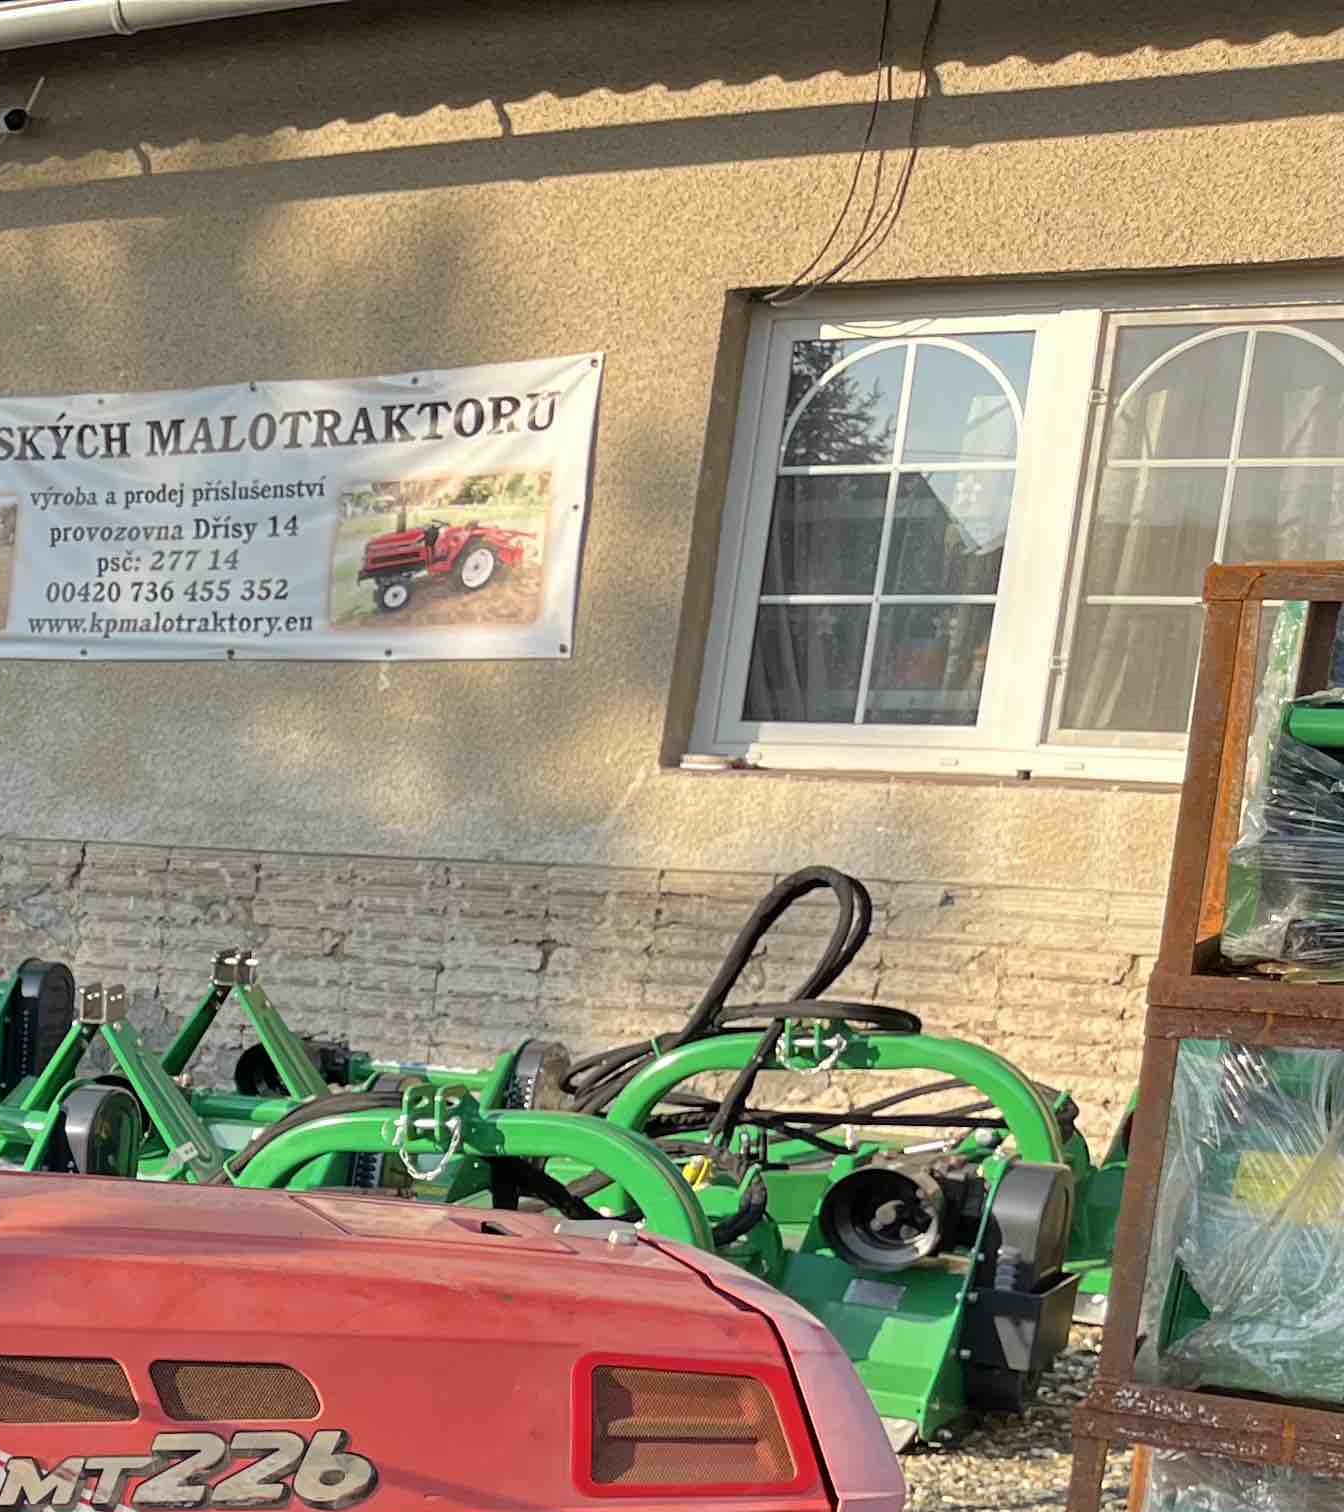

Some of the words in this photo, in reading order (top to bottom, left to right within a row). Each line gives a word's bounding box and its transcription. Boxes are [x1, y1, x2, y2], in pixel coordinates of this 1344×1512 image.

[30, 486, 97, 511] výroba
[105, 489, 117, 505] a
[123, 483, 185, 509] prodej
[192, 475, 327, 507] příslušenství
[49, 525, 183, 548] provozovna
[192, 515, 258, 544] Dřísy
[267, 514, 300, 538] 14
[96, 549, 141, 578] psč:
[149, 549, 200, 571] 277
[207, 548, 239, 571] 14
[46, 581, 121, 602] 00420
[130, 581, 174, 602] 736
[183, 579, 232, 602] 455
[240, 578, 289, 601] 352
[27, 611, 313, 639] www.kpmalotraktory.eu
